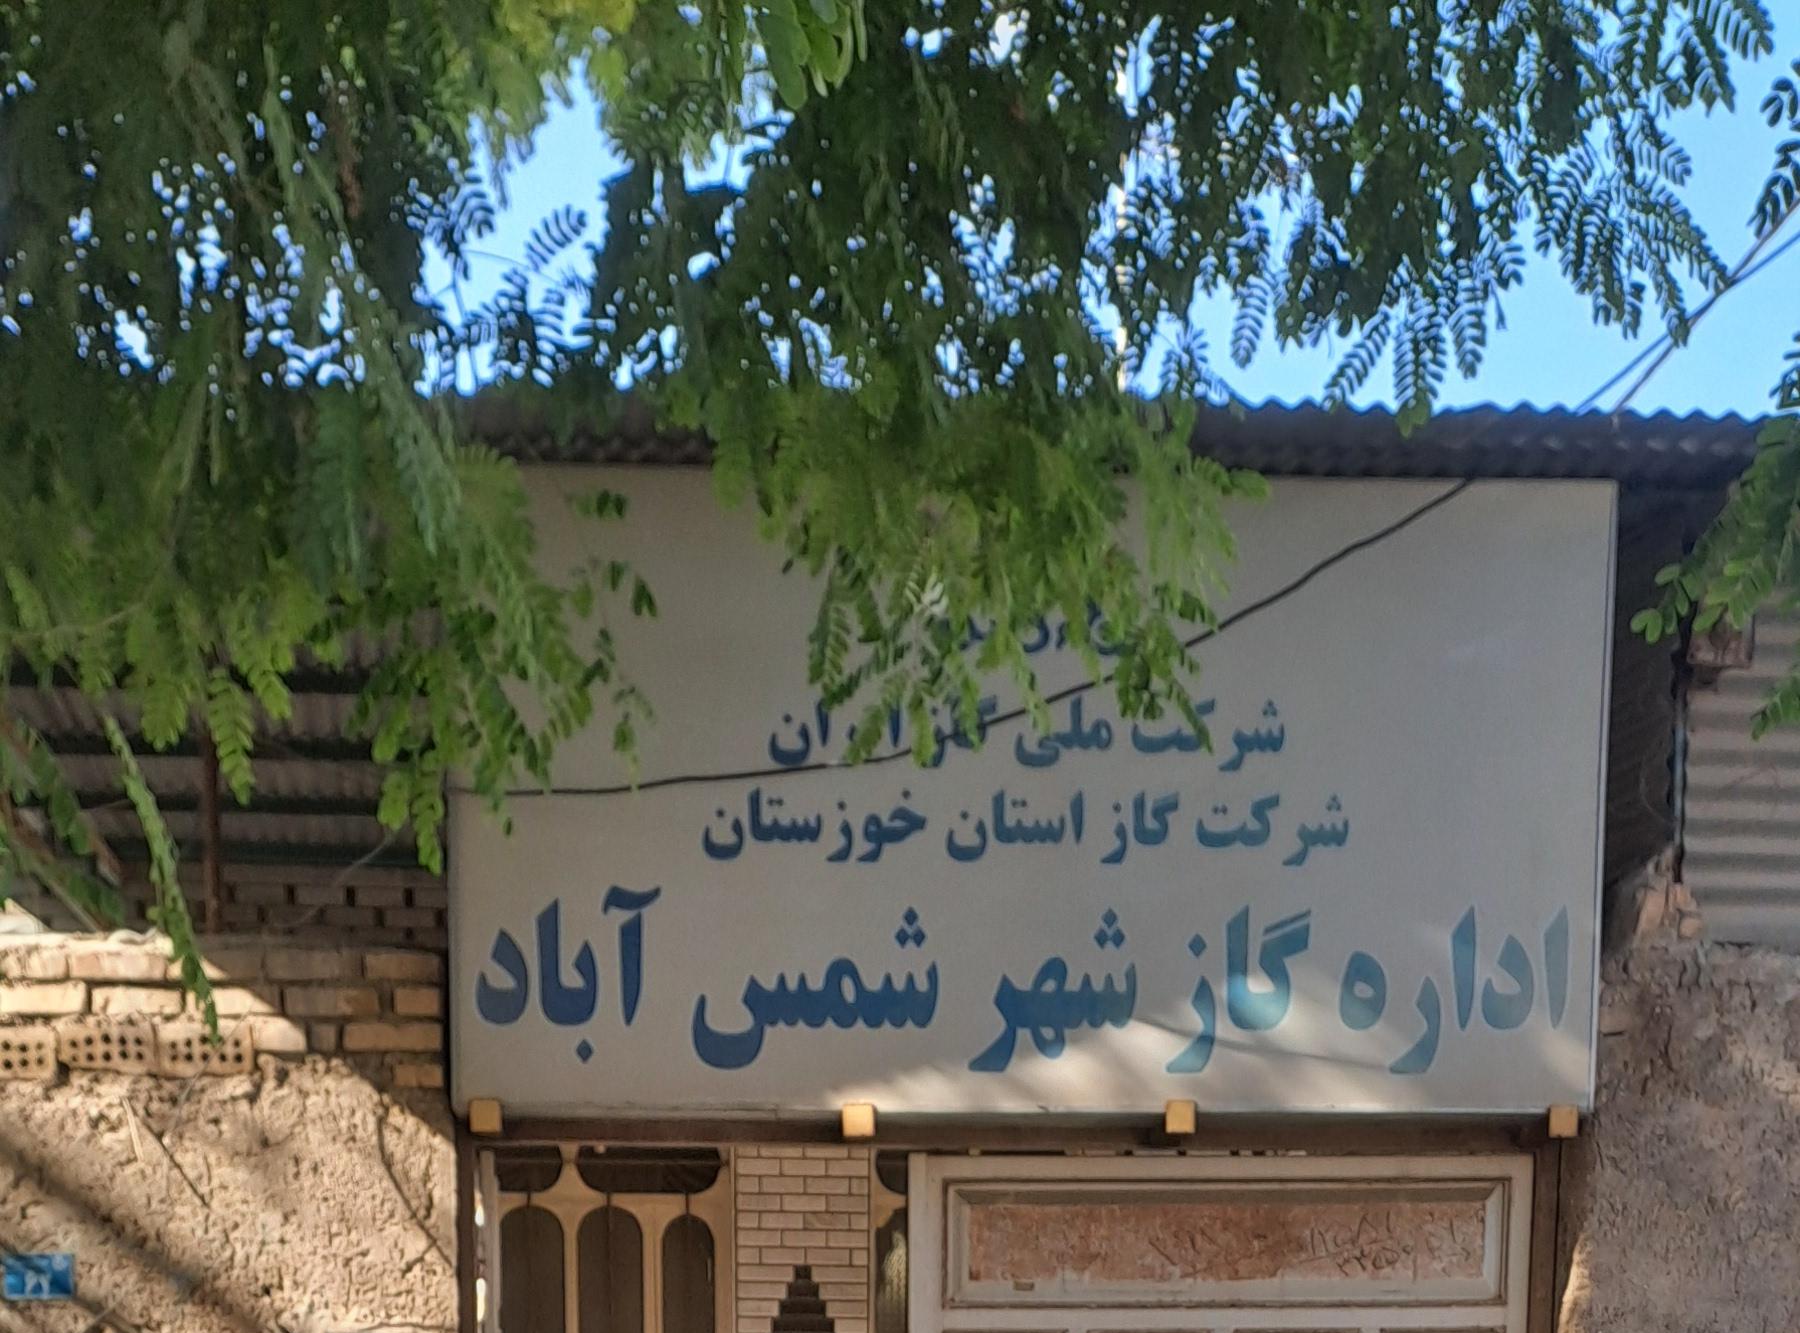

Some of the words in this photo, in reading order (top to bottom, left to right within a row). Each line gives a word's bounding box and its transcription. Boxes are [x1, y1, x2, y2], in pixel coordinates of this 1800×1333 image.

[1014, 695, 1112, 768] ملی
[703, 787, 927, 862] خوزستان
[945, 788, 1084, 862] استان
[1100, 790, 1180, 864] گاز
[1195, 793, 1349, 866] شرکت
[475, 884, 661, 1065] آباد
[692, 906, 937, 1070] شمس
[967, 907, 1137, 1073] شهر
[1165, 904, 1312, 1073] گاز
[1338, 903, 1569, 1074] اداره
